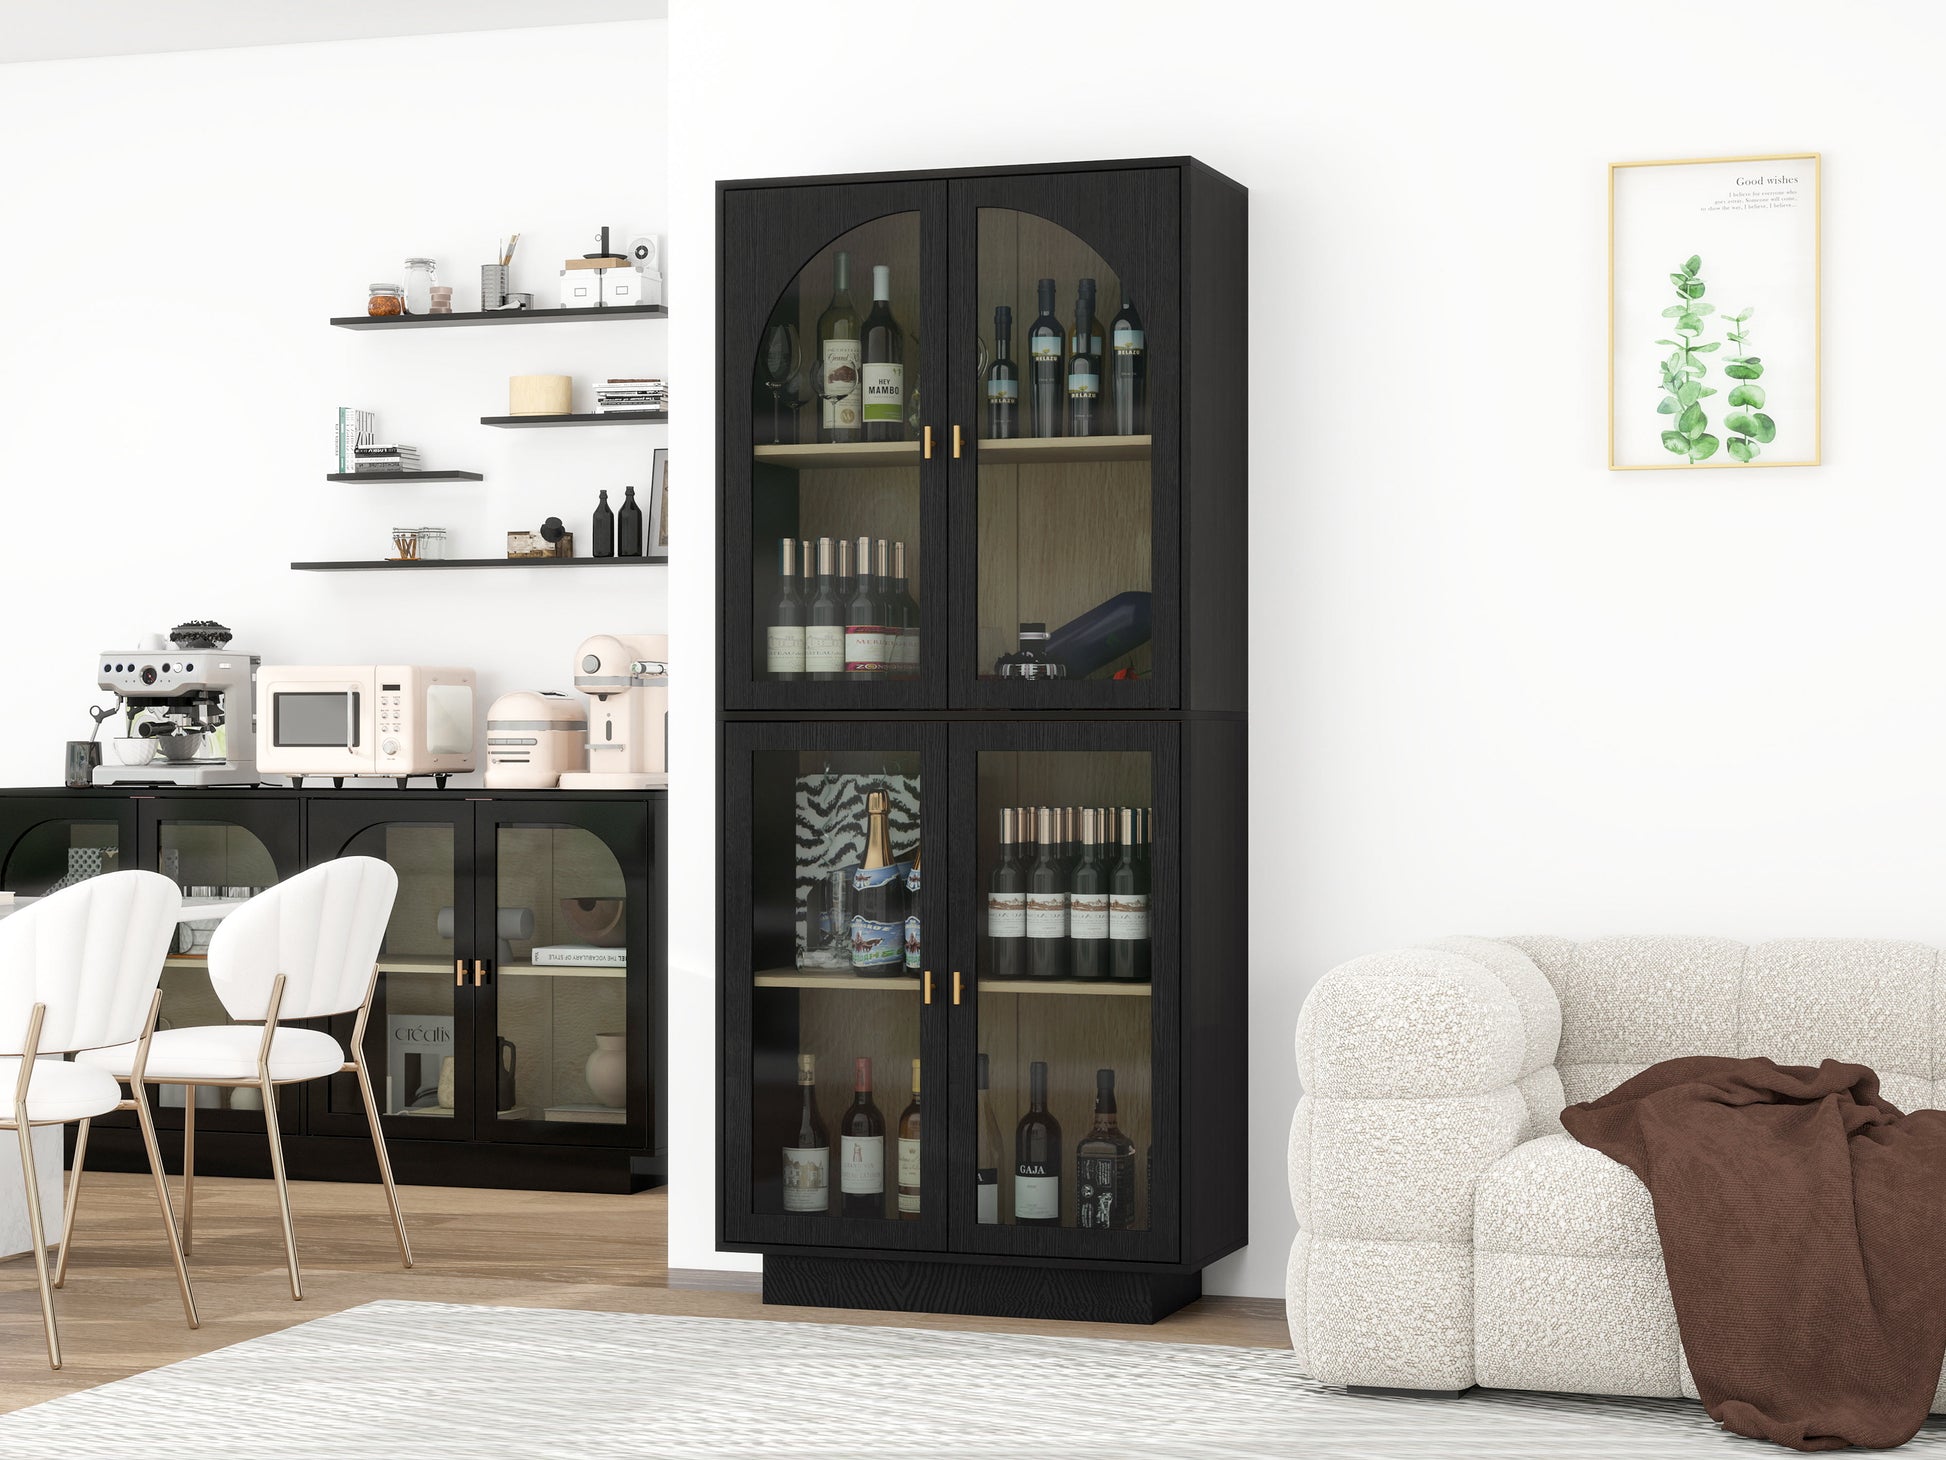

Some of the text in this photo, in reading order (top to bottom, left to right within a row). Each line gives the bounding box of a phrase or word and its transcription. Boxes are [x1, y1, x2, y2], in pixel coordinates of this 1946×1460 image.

[1736, 175, 1799, 187] Good wishes
[868, 386, 900, 395] MAMBO
[549, 953, 564, 961] STYLE
[1020, 1164, 1045, 1175] GAJA
